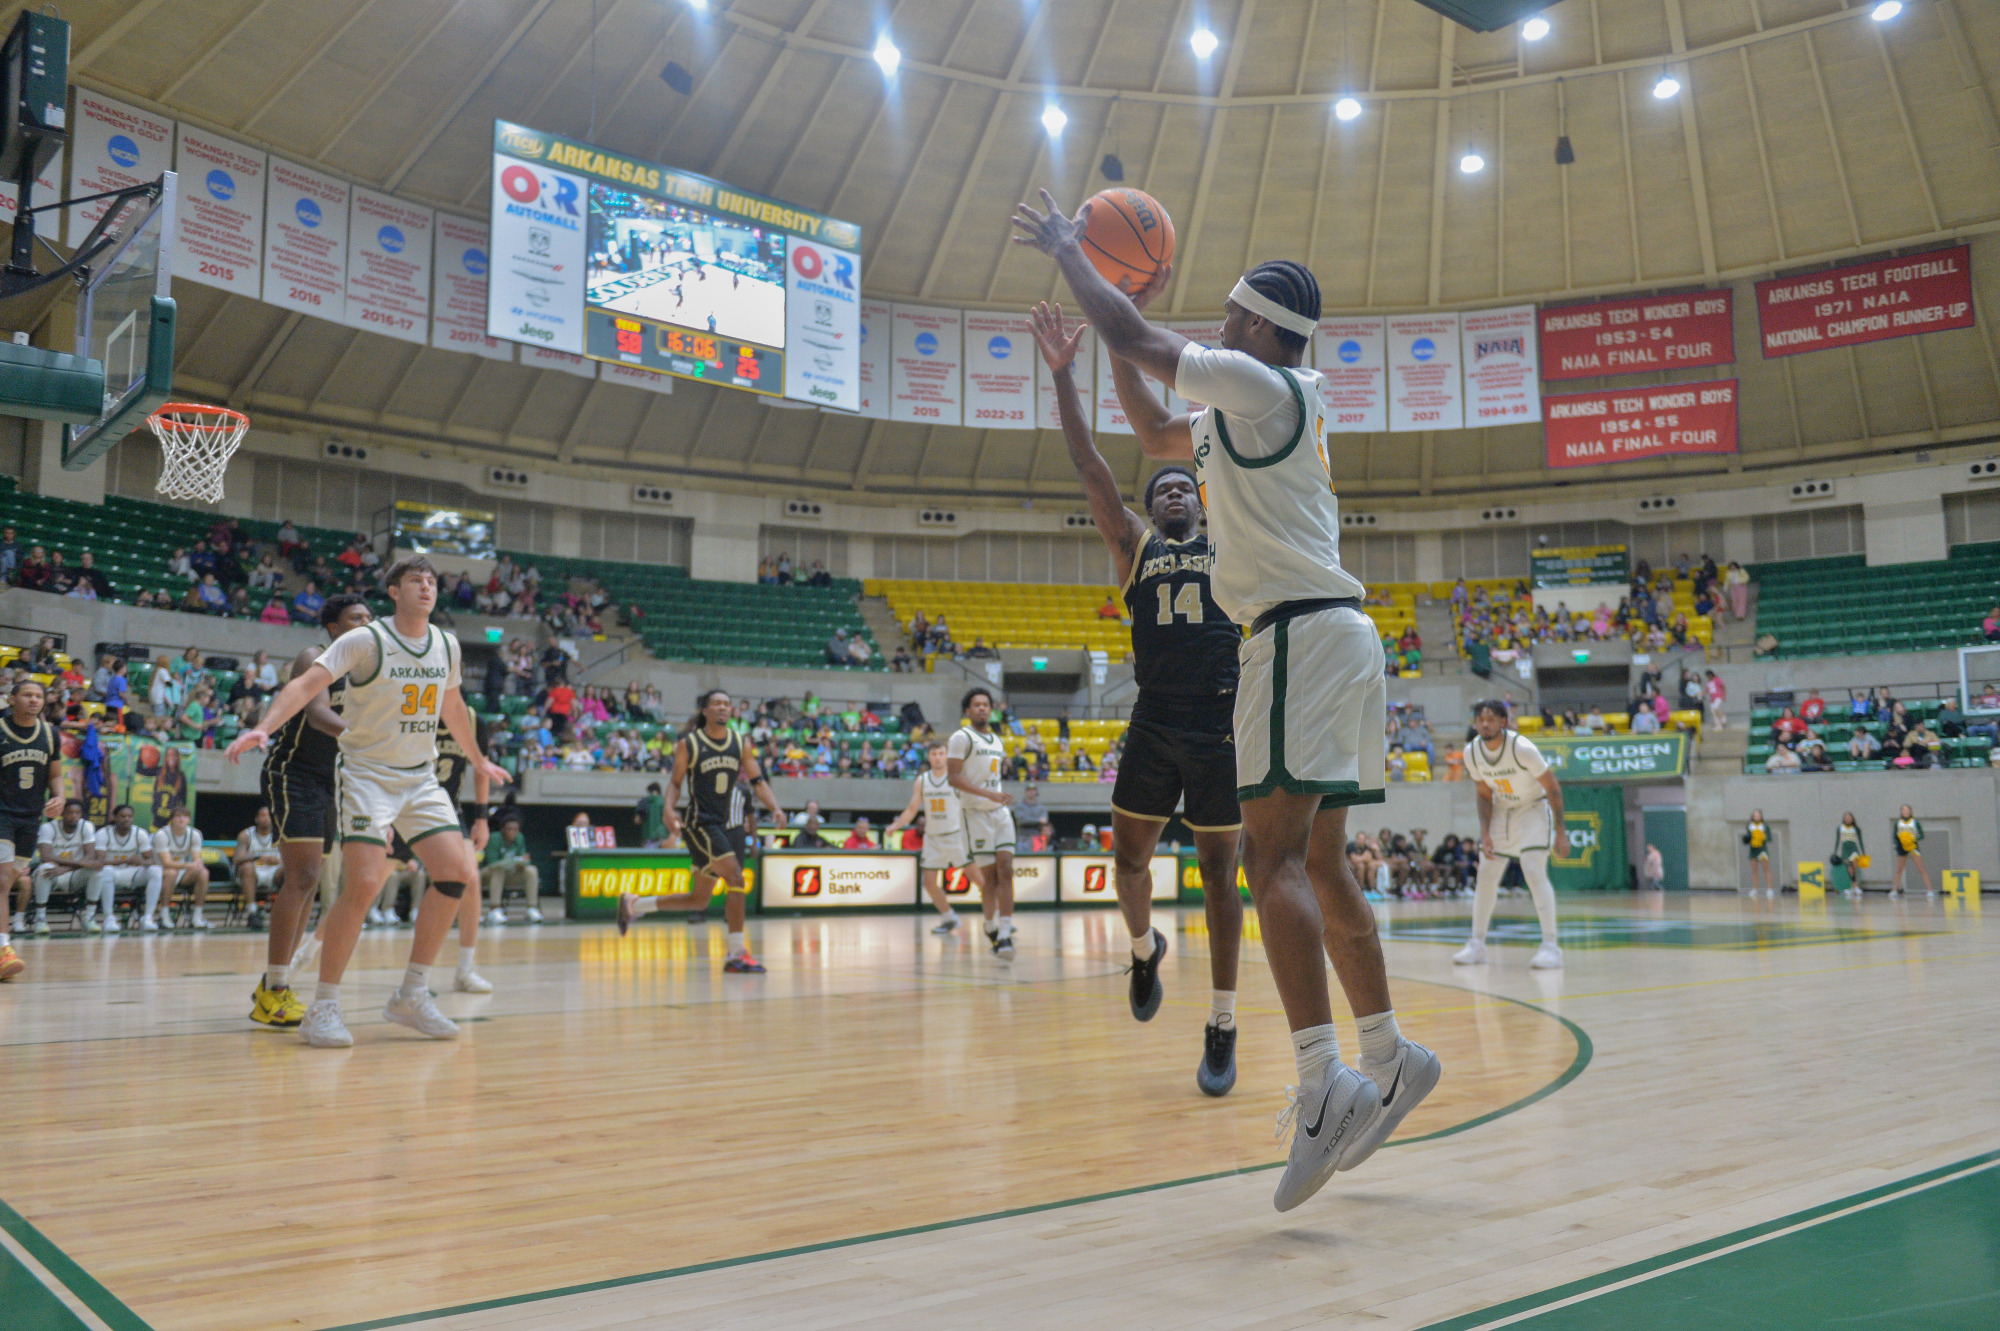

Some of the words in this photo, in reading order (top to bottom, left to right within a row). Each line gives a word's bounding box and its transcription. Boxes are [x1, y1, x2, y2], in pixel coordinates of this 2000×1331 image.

[82, 99, 138, 124] ARKANSAS
[142, 120, 168, 134] TECH
[85, 110, 134, 132] WOMEN'S
[138, 129, 164, 142] GOLF
[184, 136, 234, 159] ARKANSAS
[238, 155, 261, 168] TECH
[186, 146, 230, 167] WOMEN'S
[233, 164, 258, 176] GOLF
[274, 166, 320, 188] ARKANSAS
[501, 165, 580, 217] ORR
[547, 142, 660, 190] ARKANSAS
[665, 174, 714, 206] TECH
[716, 190, 822, 236] UNIVERSITY
[506, 204, 580, 232] AUTOMALL
[200, 261, 234, 281] 2015
[792, 246, 855, 290] ORR
[796, 280, 854, 303] AUTOMALL
[1768, 280, 1834, 305] ARKANSAS
[1840, 272, 1876, 292] TECH
[1884, 258, 1958, 284] FOOTBALL
[290, 287, 322, 305] 2016
[1815, 301, 1852, 318] 1971
[1863, 290, 1910, 310] NAIA
[362, 308, 413, 330] 2016-17
[1545, 312, 1602, 332] ARKANSAS
[1608, 308, 1638, 325] TECH
[1644, 303, 1690, 322] WONDER
[1694, 299, 1726, 316] BOYS
[1766, 326, 1822, 348] NATIONAL
[1828, 314, 1888, 338] CHAMPION
[1893, 302, 1968, 327] RUNNER-UP
[520, 323, 554, 341] Jeep
[617, 330, 642, 354] 58
[1477, 338, 1521, 358] NAIA
[1562, 354, 1600, 370] NAIA
[1608, 348, 1658, 366] FINAL
[1665, 342, 1712, 360] FOUR
[737, 356, 760, 380] 25
[809, 385, 837, 402] Jeep
[1550, 401, 1606, 420] ARKANSAS
[1612, 398, 1644, 414] TECH
[1648, 392, 1696, 411] WONDER
[1701, 388, 1732, 405] BOYS
[912, 406, 940, 417] 2015
[976, 408, 1024, 420] 2022-23
[1338, 414, 1364, 424] 2017
[1412, 411, 1440, 421] 2021
[1478, 404, 1528, 418] 1994-95
[1566, 440, 1606, 458] NAIA
[1612, 434, 1663, 453] FINAL
[1670, 430, 1716, 445] FOUR
[1157, 582, 1203, 625] 14
[389, 667, 446, 679] ARKANSAS
[401, 684, 438, 716] 34
[400, 721, 436, 734] TECH
[1575, 743, 1670, 760] GOLDEN
[19, 766, 34, 790] 5
[1591, 759, 1656, 774] SUNS
[716, 772, 728, 794] 0
[580, 868, 691, 897] WONDER
[829, 869, 890, 880] Simmons
[1801, 868, 1822, 889] A
[1952, 872, 1970, 892] T
[828, 882, 862, 894] Bank
